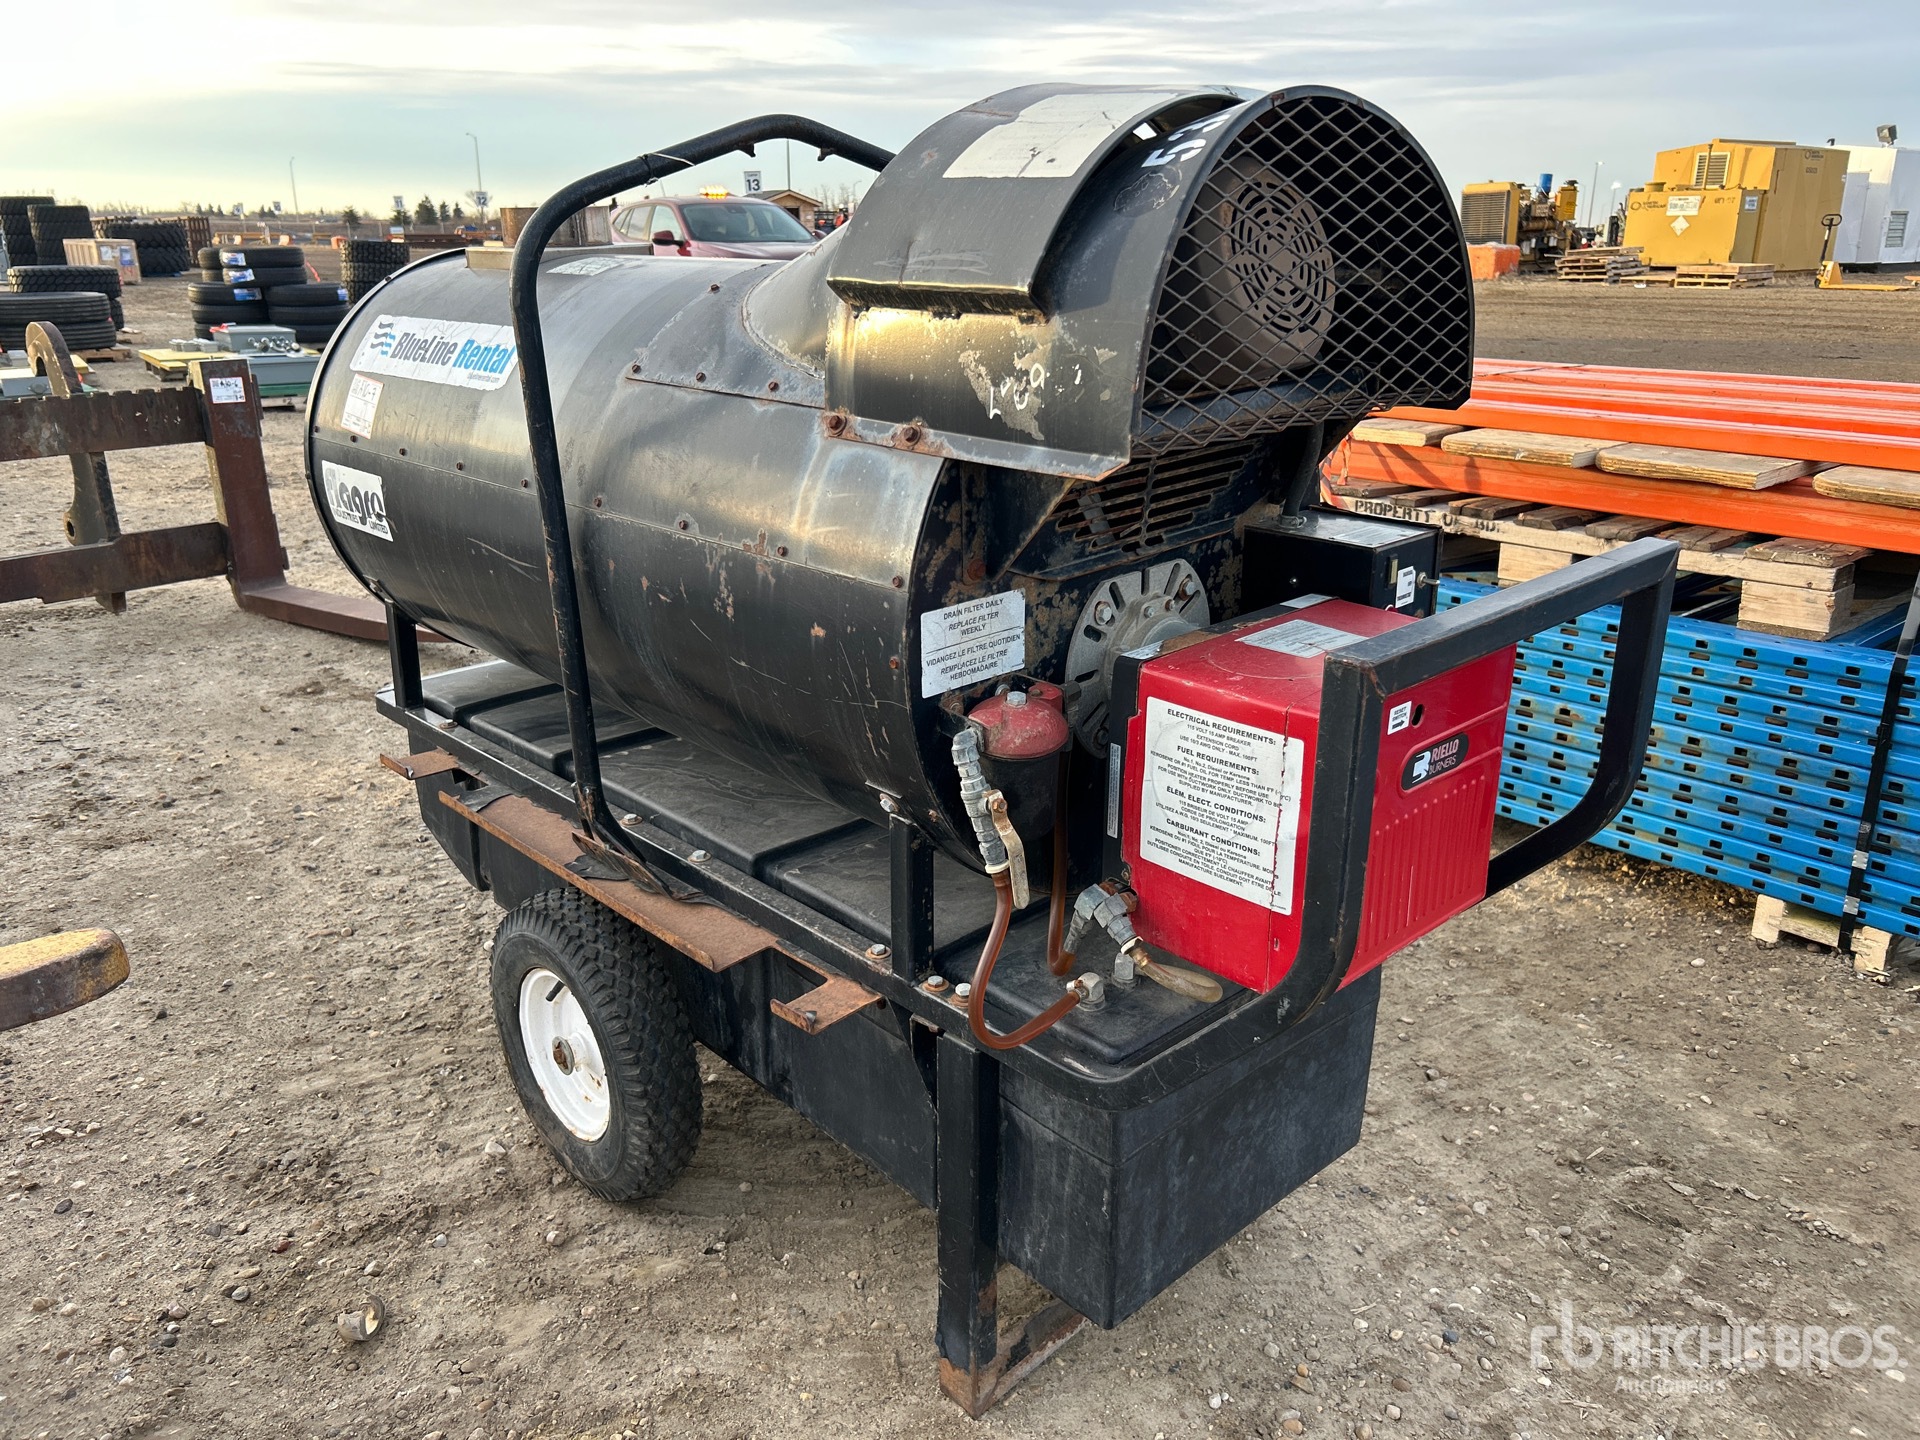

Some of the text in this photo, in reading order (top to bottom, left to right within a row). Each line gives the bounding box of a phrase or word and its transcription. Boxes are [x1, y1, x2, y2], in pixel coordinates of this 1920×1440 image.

[746, 179, 760, 191] 13
[477, 196, 487, 206] 12
[390, 332, 516, 374] BlueLine Rental
[1355, 500, 1436, 523] PROPERTY
[944, 598, 1004, 620] DRAIN FILTER DAILY
[949, 611, 999, 631] REPLACE FILTER
[961, 623, 986, 636] WEEKLY
[927, 633, 1020, 667] VIDANGEZ LE FILTRE QUOTIDIEN
[941, 649, 1008, 675] REMPLACEZ LE FILTRE
[950, 661, 998, 681] HEBDOMADAIRE
[1392, 712, 1407, 722] SWITCH
[1394, 706, 1407, 716] RESET
[1168, 708, 1276, 746] ELECTRICAL REQUIREMENTS:
[1197, 734, 1239, 751] EXTENSION CORD
[1200, 741, 1211, 749] AWG
[1212, 745, 1225, 753] ONLY
[1215, 732, 1225, 740] AMP
[1227, 736, 1251, 747] BREAKER
[1431, 739, 1459, 762] RIELLO
[1151, 751, 1173, 762] KEROSENE
[1187, 763, 1198, 772] FUEL
[1209, 770, 1219, 778] FOR
[1236, 778, 1250, 787] LESS
[1251, 782, 1265, 791] THAN
[1177, 746, 1259, 777] FUEL REQUIREMENTS:
[1208, 765, 1222, 773] Diesel
[1428, 755, 1457, 775] BURNERS
[1168, 764, 1188, 775] POSITION
[1188, 772, 1206, 782] HEATER
[1208, 778, 1234, 790] PROPERLY
[1236, 785, 1257, 796] BEFORE
[1177, 773, 1188, 781] WITH
[1189, 777, 1216, 791] DUCTWORK
[1233, 790, 1264, 805] DUCTWORK
[1179, 780, 1200, 791] SUPPLIED
[1156, 802, 1174, 813] UTILISEZ
[1200, 818, 1229, 833] SEULEMENT
[1181, 806, 1197, 816] CORDE
[1206, 814, 1245, 833] PROLONGATION
[1187, 803, 1207, 814] BRISEUR
[1217, 812, 1229, 821] VOLT
[1237, 819, 1248, 827] AMP
[1188, 794, 1212, 808] ELECT.
[1214, 800, 1266, 826] CONDITIONS:
[1167, 818, 1261, 858] CARBURANT CONDITIONS:
[1194, 848, 1204, 856] QUE
[1202, 845, 1216, 854] POUR
[1179, 858, 1213, 875] MANUFACTURE
[1182, 848, 1219, 867] CORRECTEMENT
[1228, 866, 1254, 880] CHAUFFER
[1255, 876, 1271, 886] AVANT
[1216, 867, 1238, 880] CONDUIT
[1239, 875, 1251, 885] DOIT
